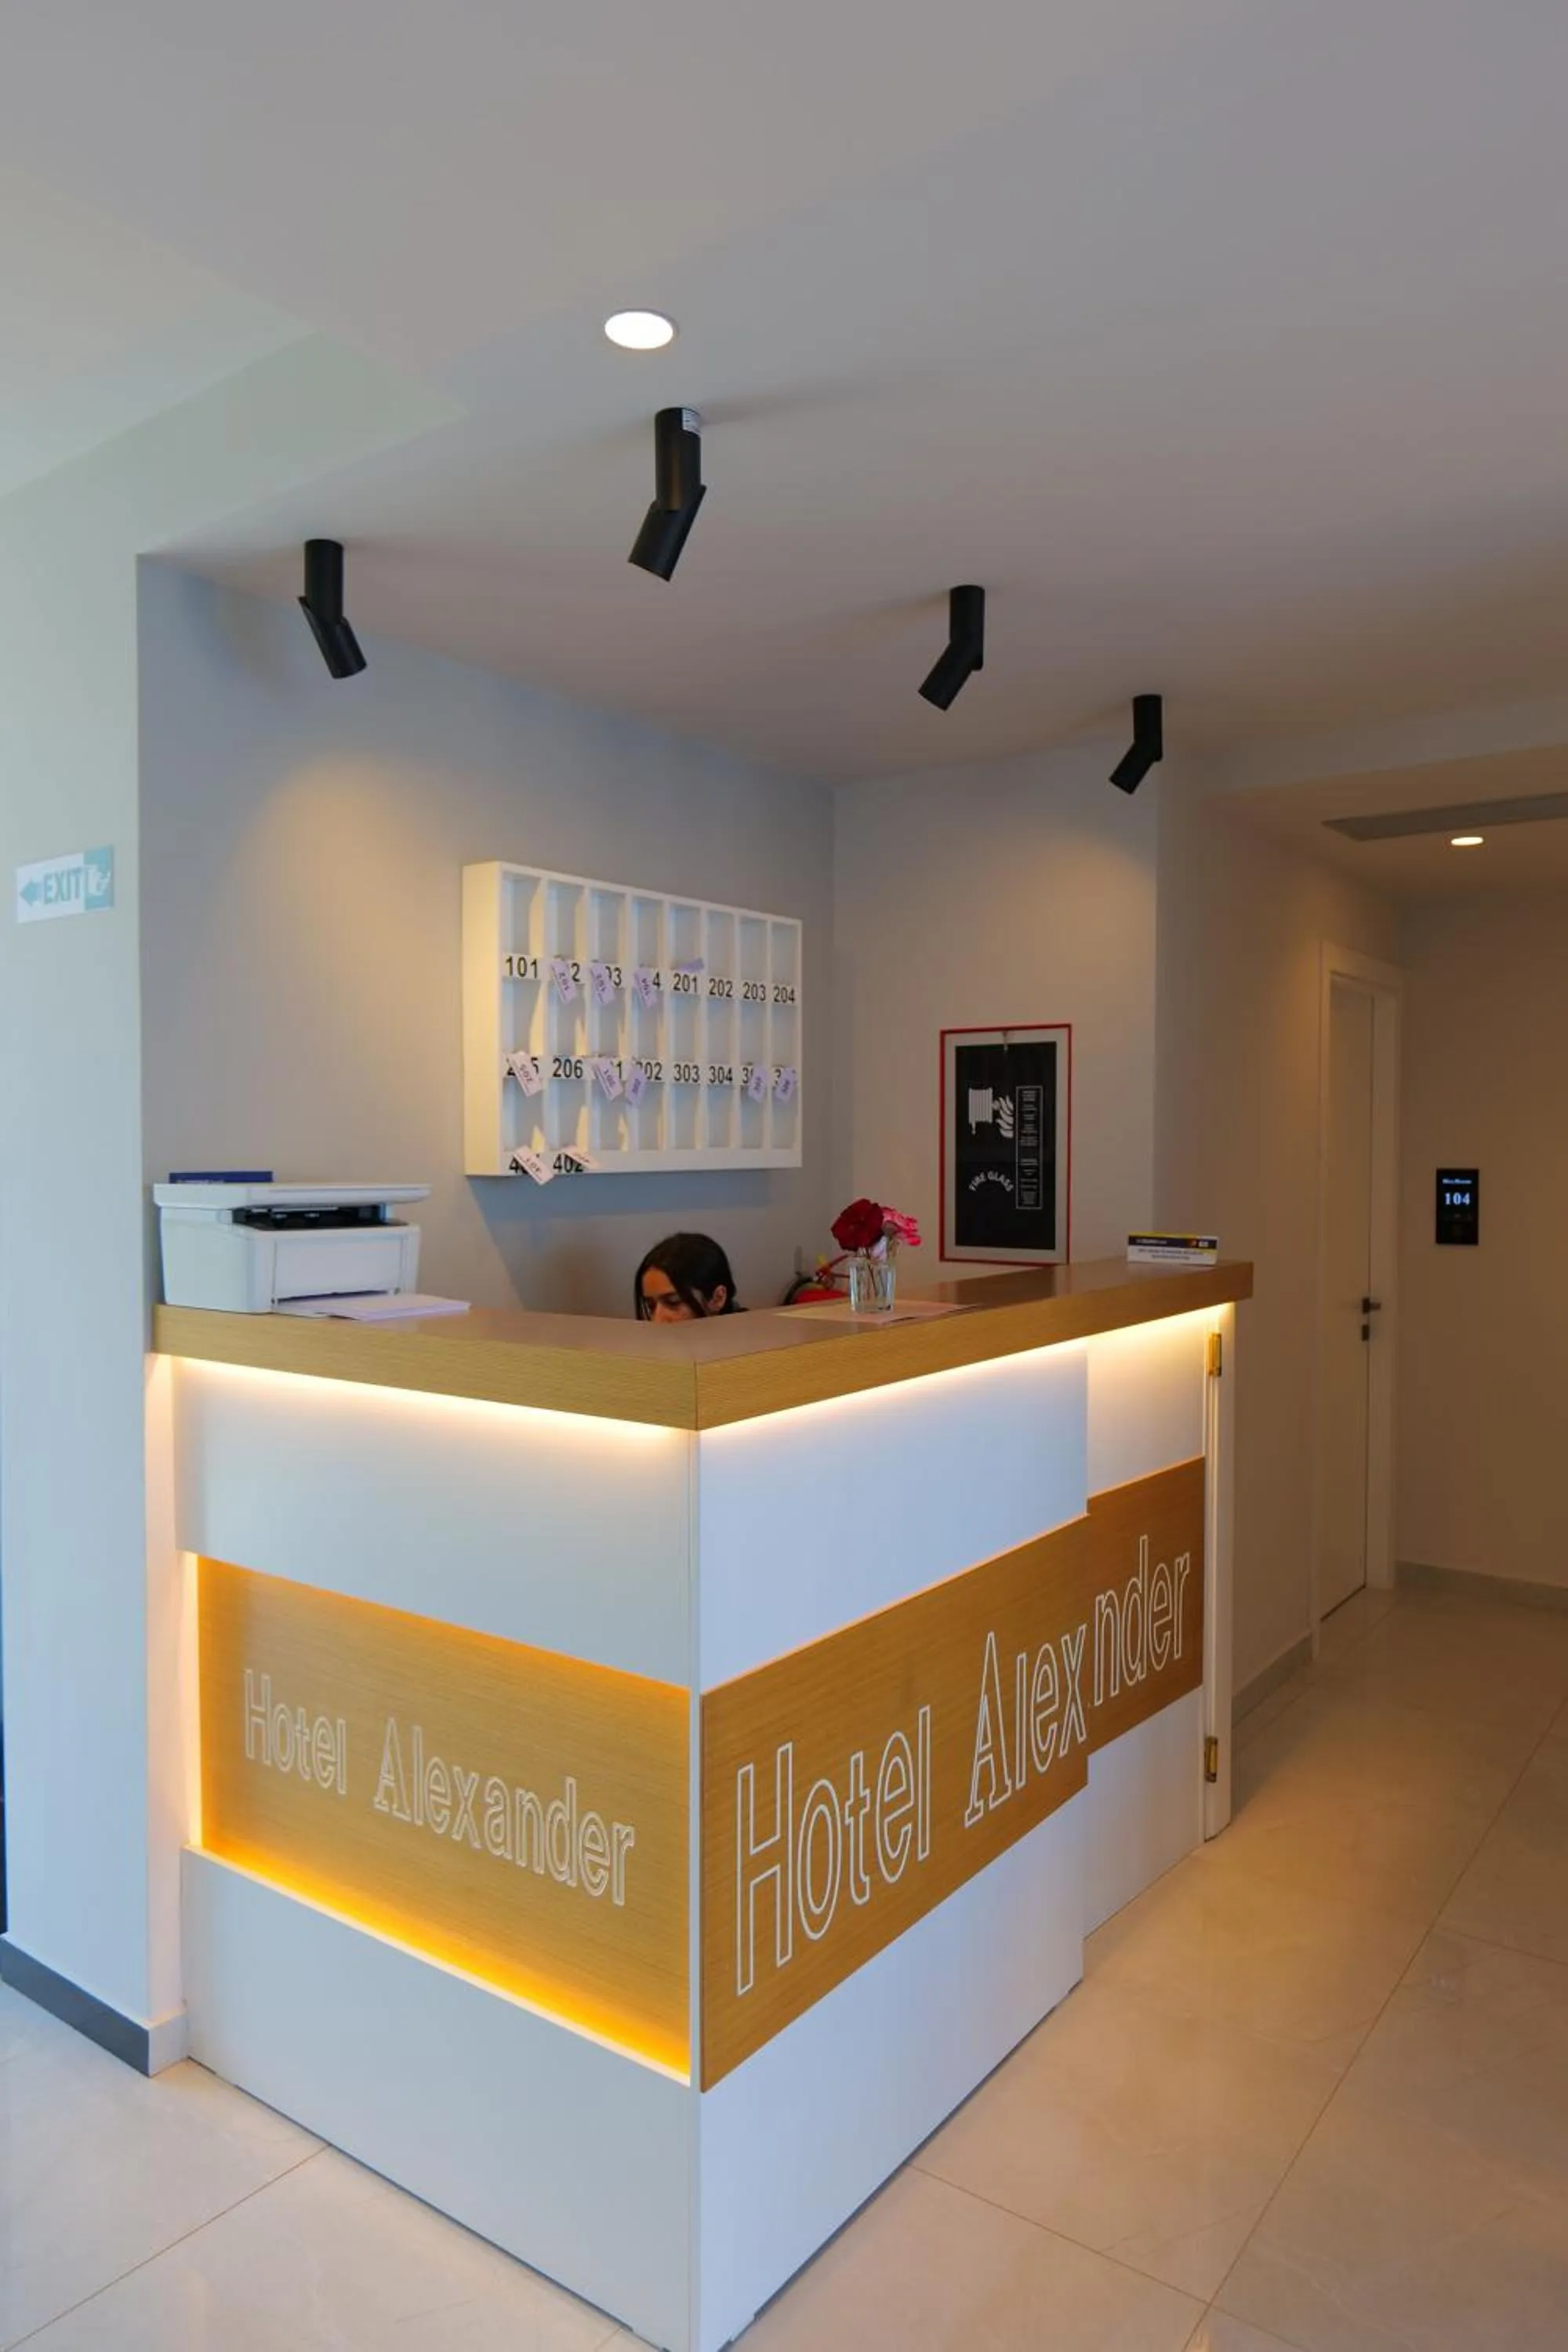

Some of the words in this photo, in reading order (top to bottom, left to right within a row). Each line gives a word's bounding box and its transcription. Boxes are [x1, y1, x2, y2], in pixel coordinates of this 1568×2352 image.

[44, 866, 82, 905] EXIT
[506, 956, 538, 979] 101
[673, 972, 698, 993] 201
[709, 978, 734, 998] 202
[742, 981, 767, 1001] 203
[773, 985, 796, 1004] 204
[553, 1058, 584, 1080] 206
[673, 1063, 701, 1083] 303
[709, 1065, 734, 1084] 304
[1445, 1192, 1470, 1205] 104
[245, 1668, 347, 1795] Hotel
[374, 1717, 635, 1906] Alexander
[737, 1704, 931, 1997] Hotel
